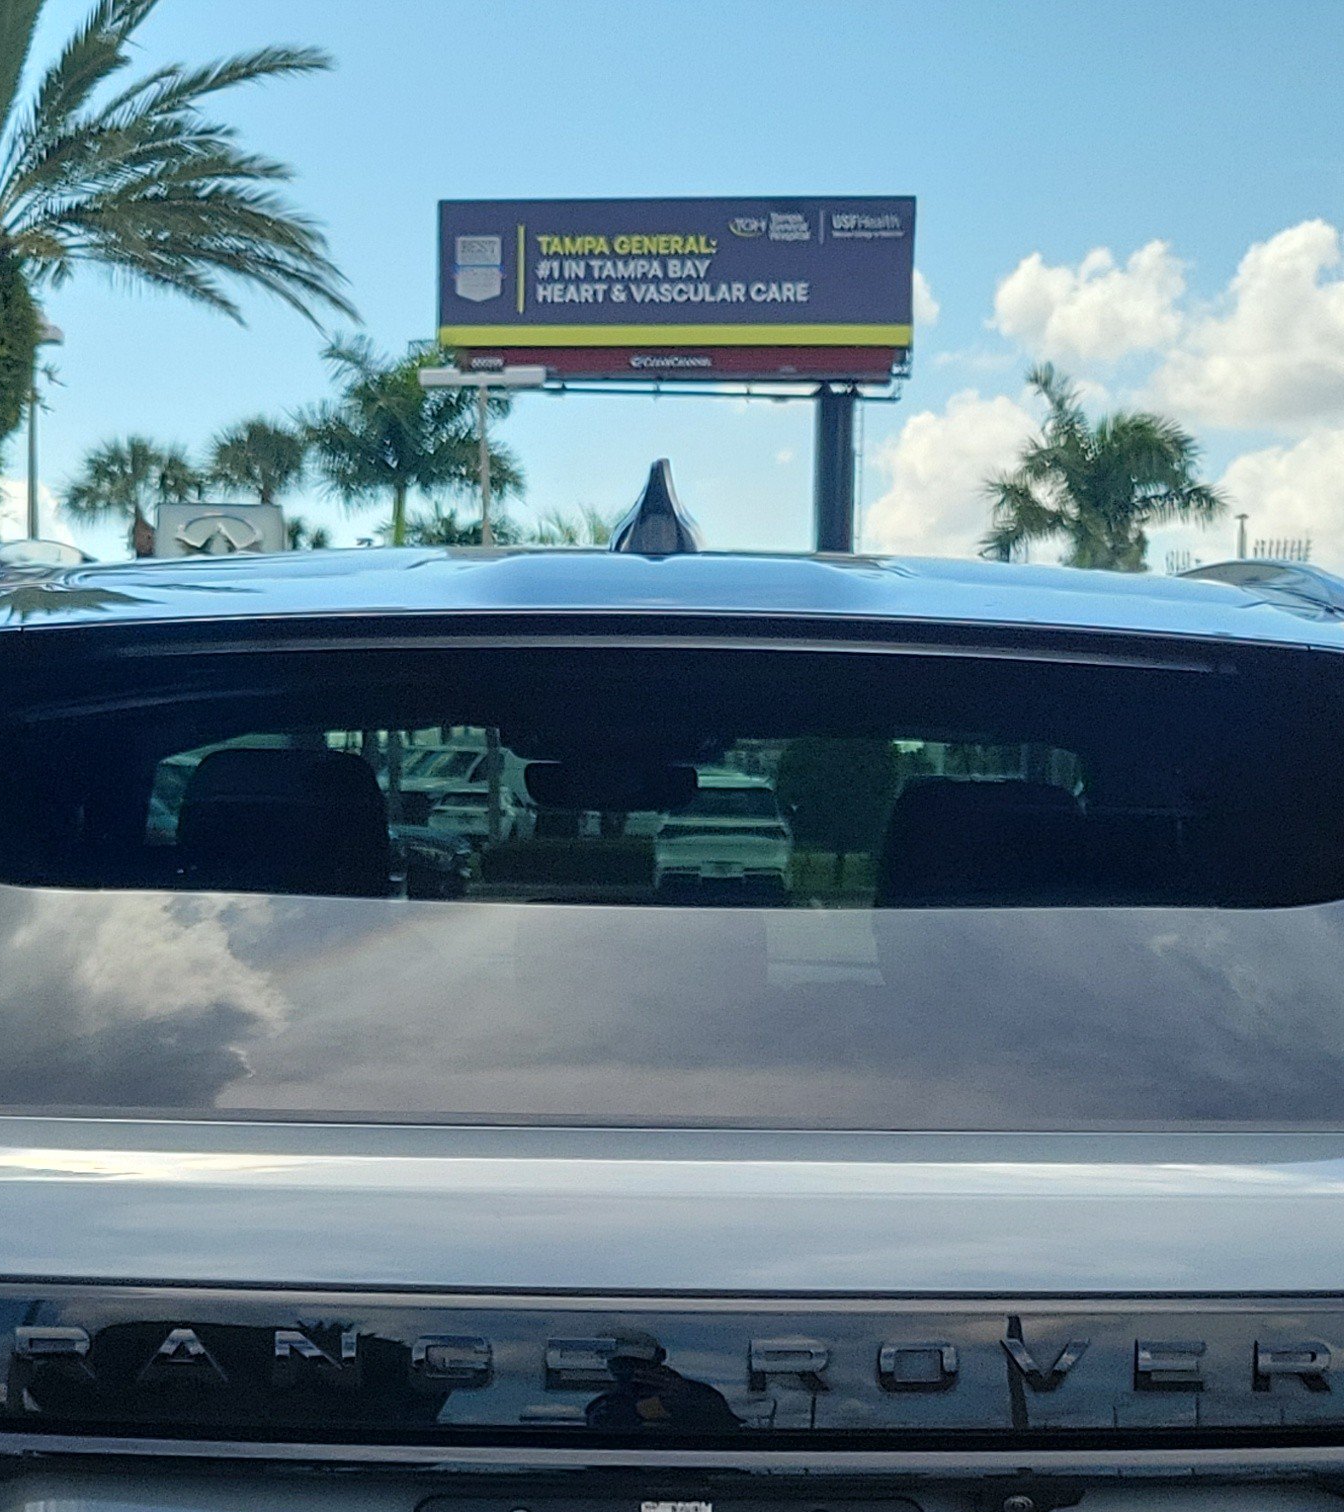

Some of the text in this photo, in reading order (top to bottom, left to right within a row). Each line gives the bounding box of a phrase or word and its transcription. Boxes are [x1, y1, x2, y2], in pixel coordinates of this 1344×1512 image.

[536, 235, 718, 256] TAMPA GENERAL:
[535, 259, 712, 280] #1 IN TAMPA BAY
[536, 283, 810, 303] HEART & VASCULAR CARE
[14, 1325, 1333, 1393] RANGE ROVER
